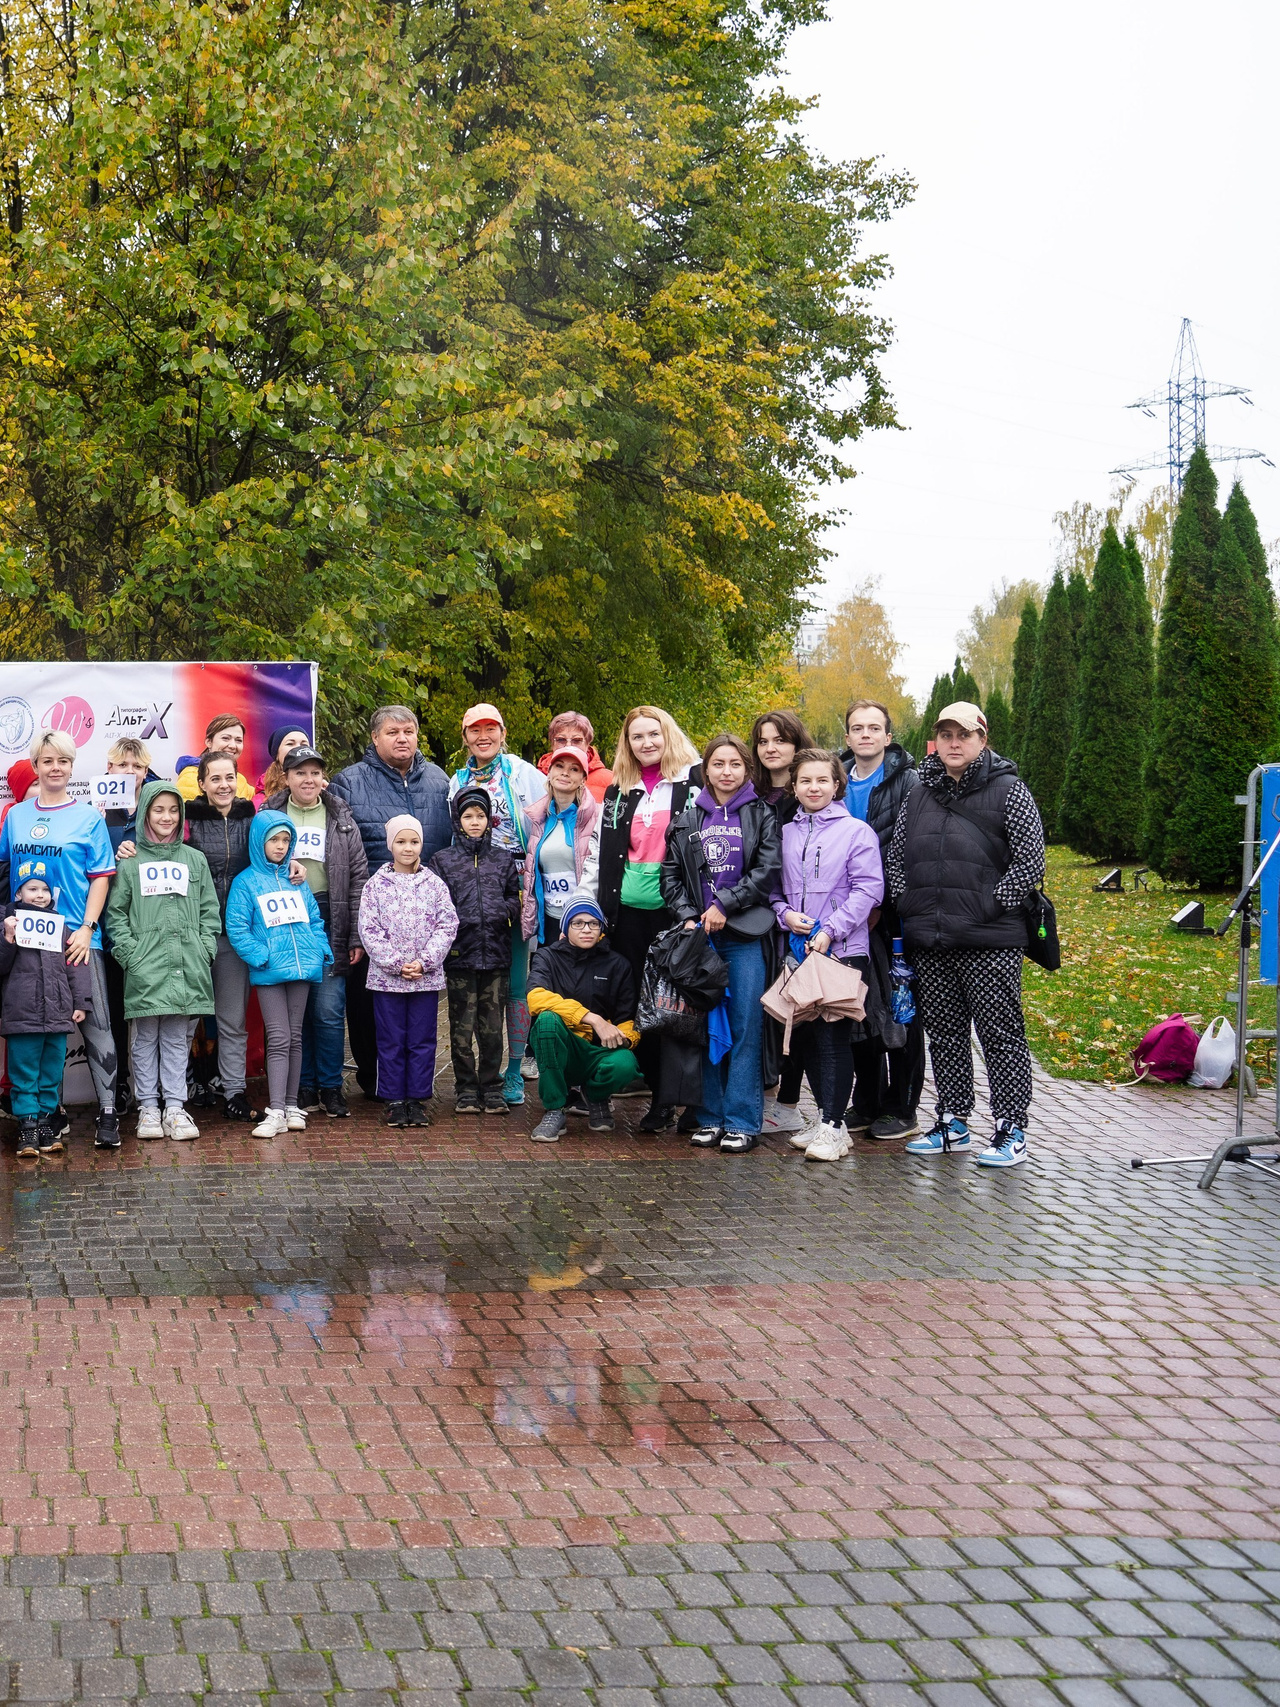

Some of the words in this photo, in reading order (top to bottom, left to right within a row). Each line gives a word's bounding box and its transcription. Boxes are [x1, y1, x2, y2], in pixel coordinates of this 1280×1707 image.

[97, 780, 126, 795] 021
[298, 832, 321, 847] 45
[146, 867, 182, 881] 010
[546, 878, 569, 893] 049
[266, 897, 298, 913] 011
[22, 917, 56, 936] 060
